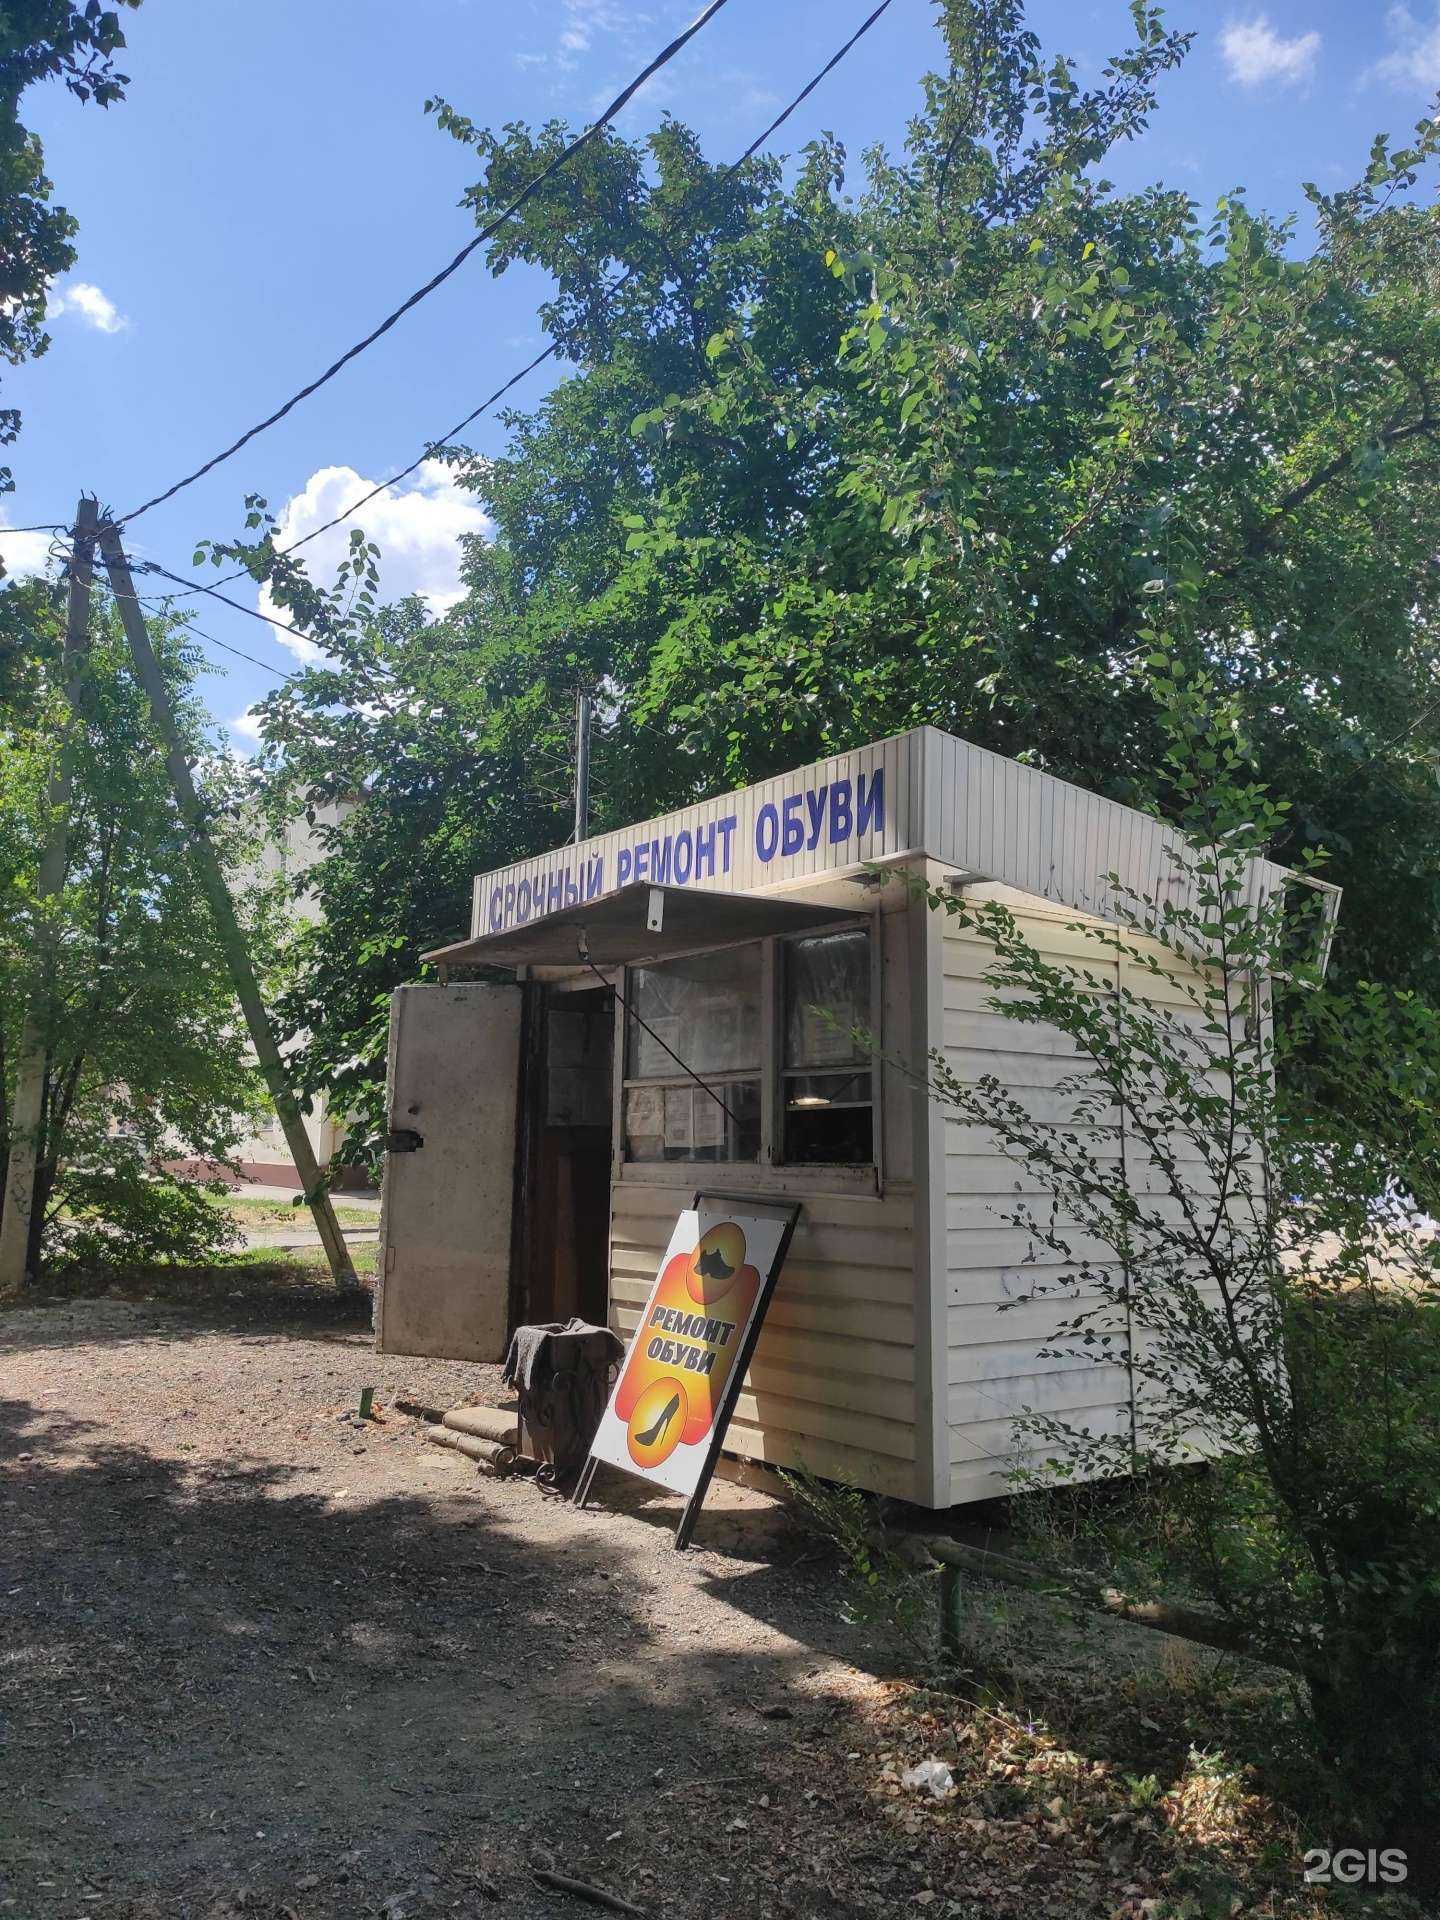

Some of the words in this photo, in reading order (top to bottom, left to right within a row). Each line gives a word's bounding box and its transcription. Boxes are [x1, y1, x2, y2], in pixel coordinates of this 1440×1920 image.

[490, 850, 603, 931] СРОЧНЫЙ
[616, 815, 737, 889] РЕМОНТ
[755, 767, 885, 863] ОБУВИ
[649, 1305, 736, 1346] РЕМОНТ
[647, 1336, 717, 1375] ОБУВИ
